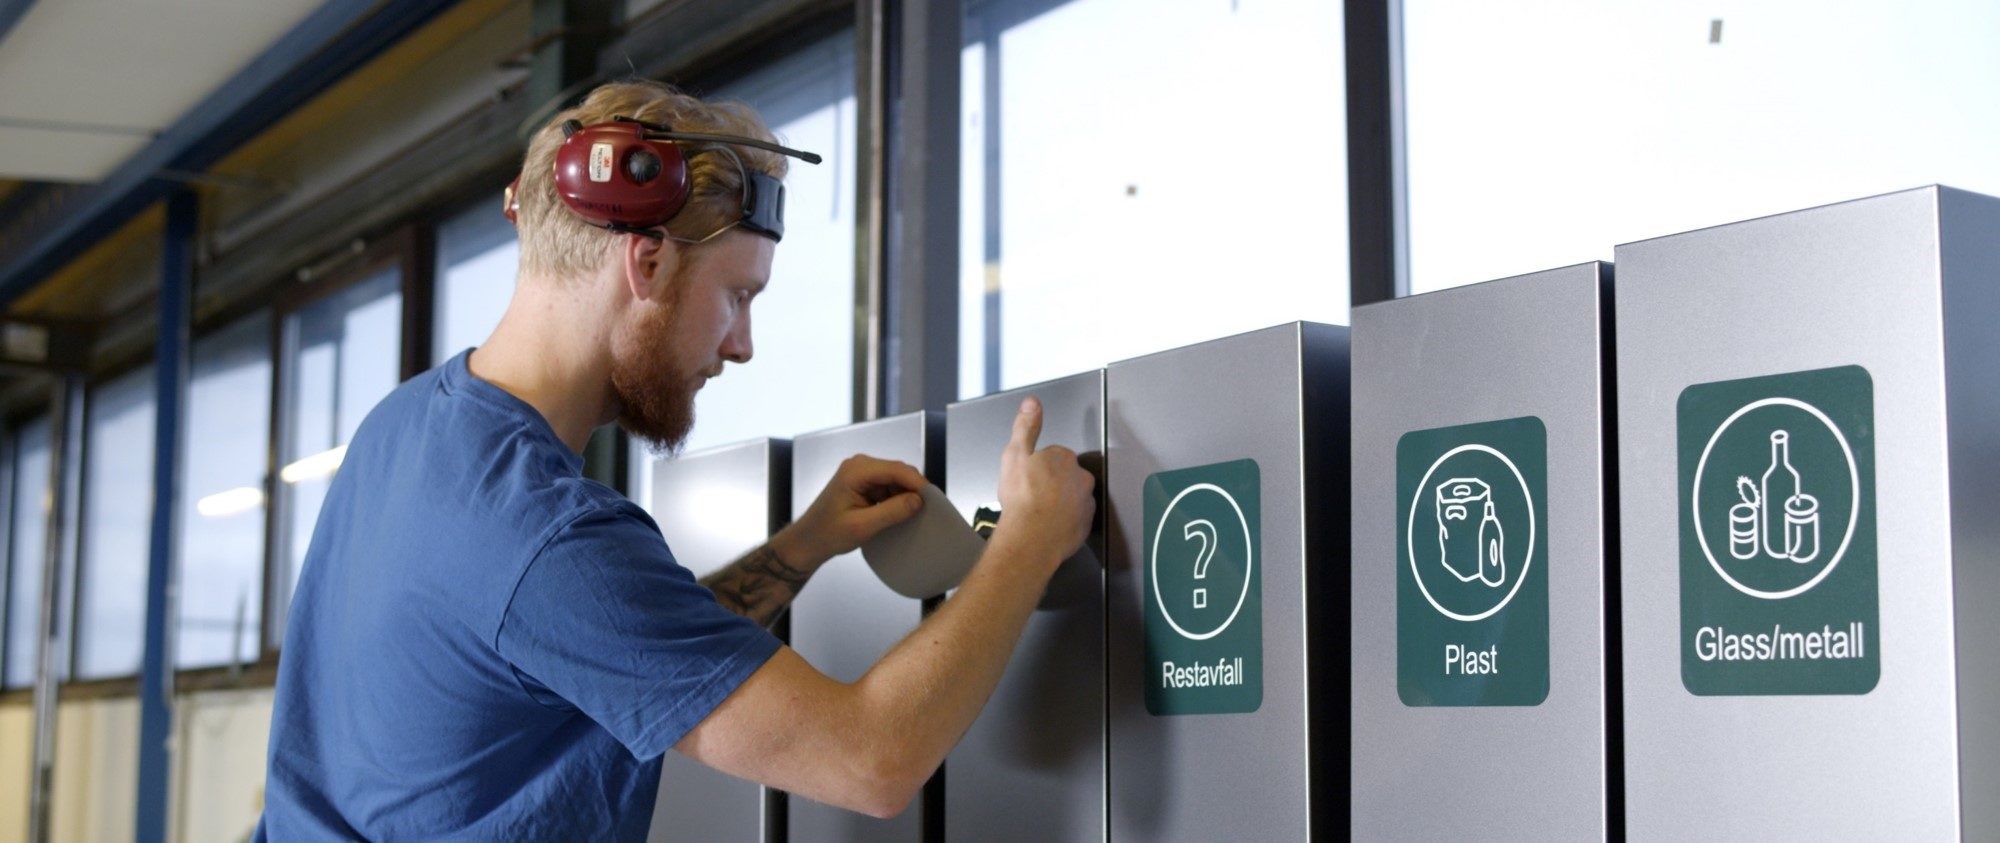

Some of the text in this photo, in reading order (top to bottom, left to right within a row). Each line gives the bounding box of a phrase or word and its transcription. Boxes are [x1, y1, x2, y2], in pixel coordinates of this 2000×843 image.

[1695, 622, 1863, 661] Glass/metall
[1163, 657, 1242, 688] Restavfall
[1445, 645, 1497, 675] Plast
